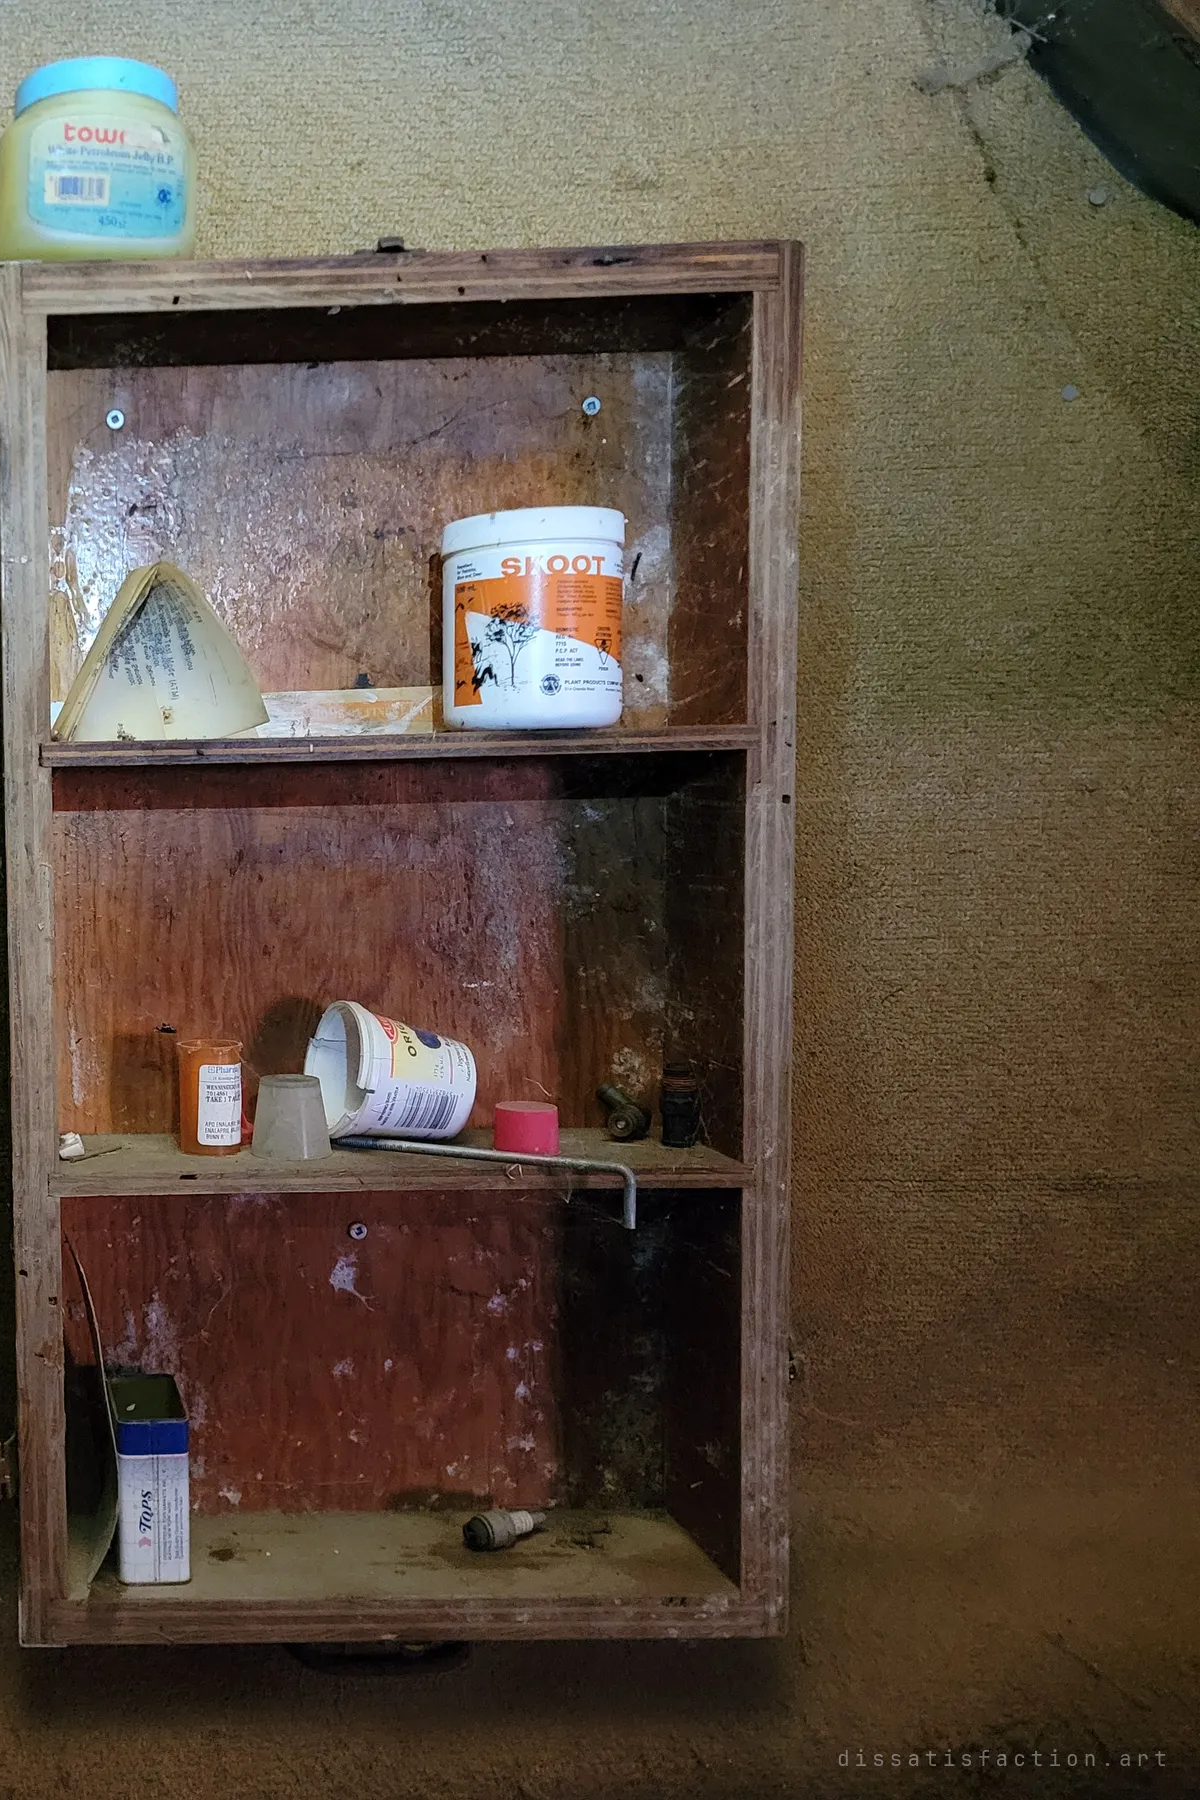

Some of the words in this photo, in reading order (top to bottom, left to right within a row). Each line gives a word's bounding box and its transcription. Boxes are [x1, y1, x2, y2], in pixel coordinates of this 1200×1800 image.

[80, 146, 131, 160] Petroleum
[133, 150, 155, 165] Jelly
[501, 555, 605, 577] SKOOT
[138, 1490, 154, 1534] TOPS
